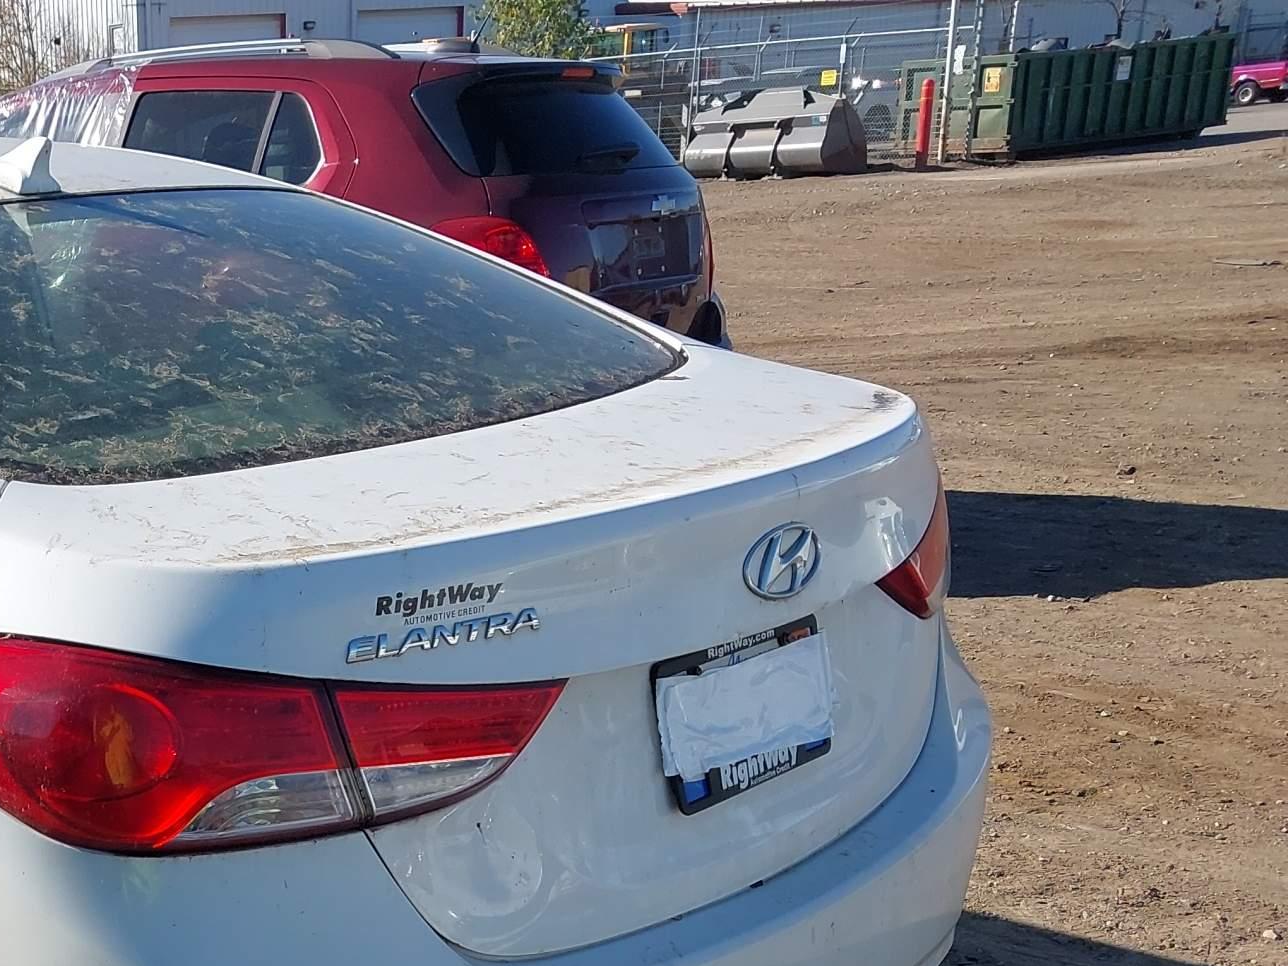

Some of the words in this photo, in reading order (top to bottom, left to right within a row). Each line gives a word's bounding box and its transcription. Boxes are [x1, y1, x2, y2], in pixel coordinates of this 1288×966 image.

[375, 582, 503, 618] RightWay
[403, 610, 456, 626] AUTOMOTIVE
[457, 605, 486, 618] CREDIT
[345, 607, 541, 665] ELANTRA
[707, 629, 775, 659] RightWay.com
